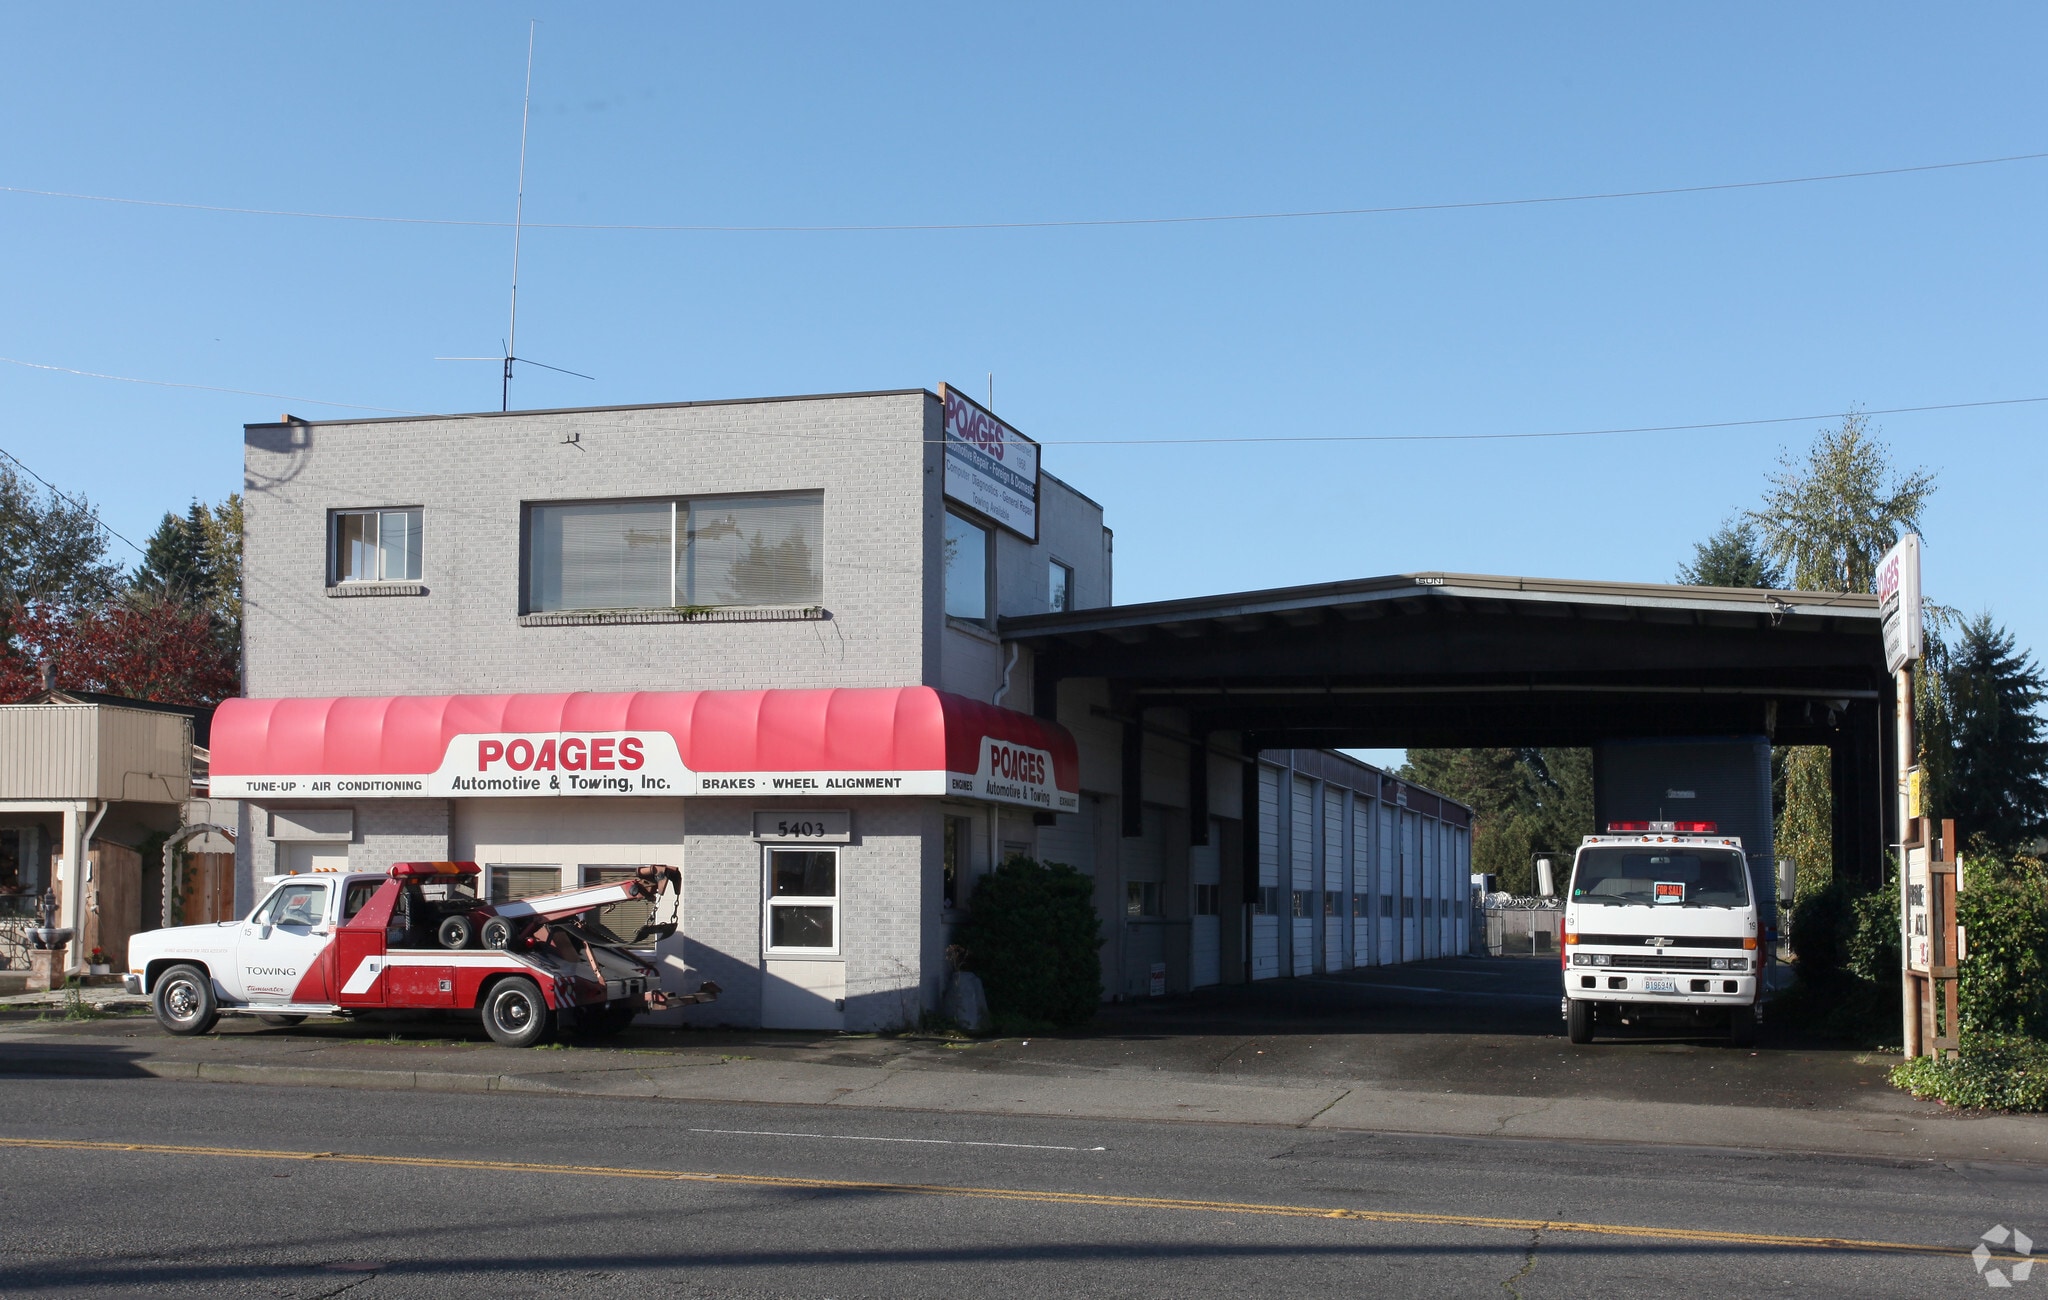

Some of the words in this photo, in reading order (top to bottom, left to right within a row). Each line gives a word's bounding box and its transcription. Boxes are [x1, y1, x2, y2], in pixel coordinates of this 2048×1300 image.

[945, 389, 1004, 461] POAGES
[972, 452, 989, 470] Repair
[992, 463, 1010, 484] Foreign
[1010, 474, 1014, 485] &
[1015, 475, 1035, 497] Domestic
[946, 459, 970, 483] Computer
[972, 473, 999, 498] Diagnostics
[1002, 490, 1019, 509] General
[1019, 500, 1033, 516] Repair
[972, 491, 989, 513] Towing
[990, 501, 1010, 521] Available
[478, 737, 645, 772] POAGES
[990, 744, 1045, 785] POAGES
[246, 781, 297, 792] TUNE-UP
[311, 781, 331, 791] AIR
[337, 780, 422, 791] CONDITIONING
[452, 775, 540, 790] Automotive
[549, 774, 560, 790] &
[569, 774, 634, 793] Towing,
[641, 774, 671, 789] Inc.
[702, 778, 756, 789] BRAKES
[773, 778, 819, 789] WHEEL
[826, 777, 902, 788] ALIGNMENT
[952, 778, 973, 792] ENGINES
[986, 780, 1021, 799] Automotive
[1023, 786, 1028, 800] &
[1030, 787, 1050, 807] Towing
[777, 821, 825, 838] 5403
[1656, 885, 1668, 896] FOR
[1668, 885, 1683, 897] SALE
[1567, 918, 1575, 926] 19
[1749, 922, 1756, 930] 19
[244, 928, 252, 937] 15
[245, 966, 297, 976] TOWING
